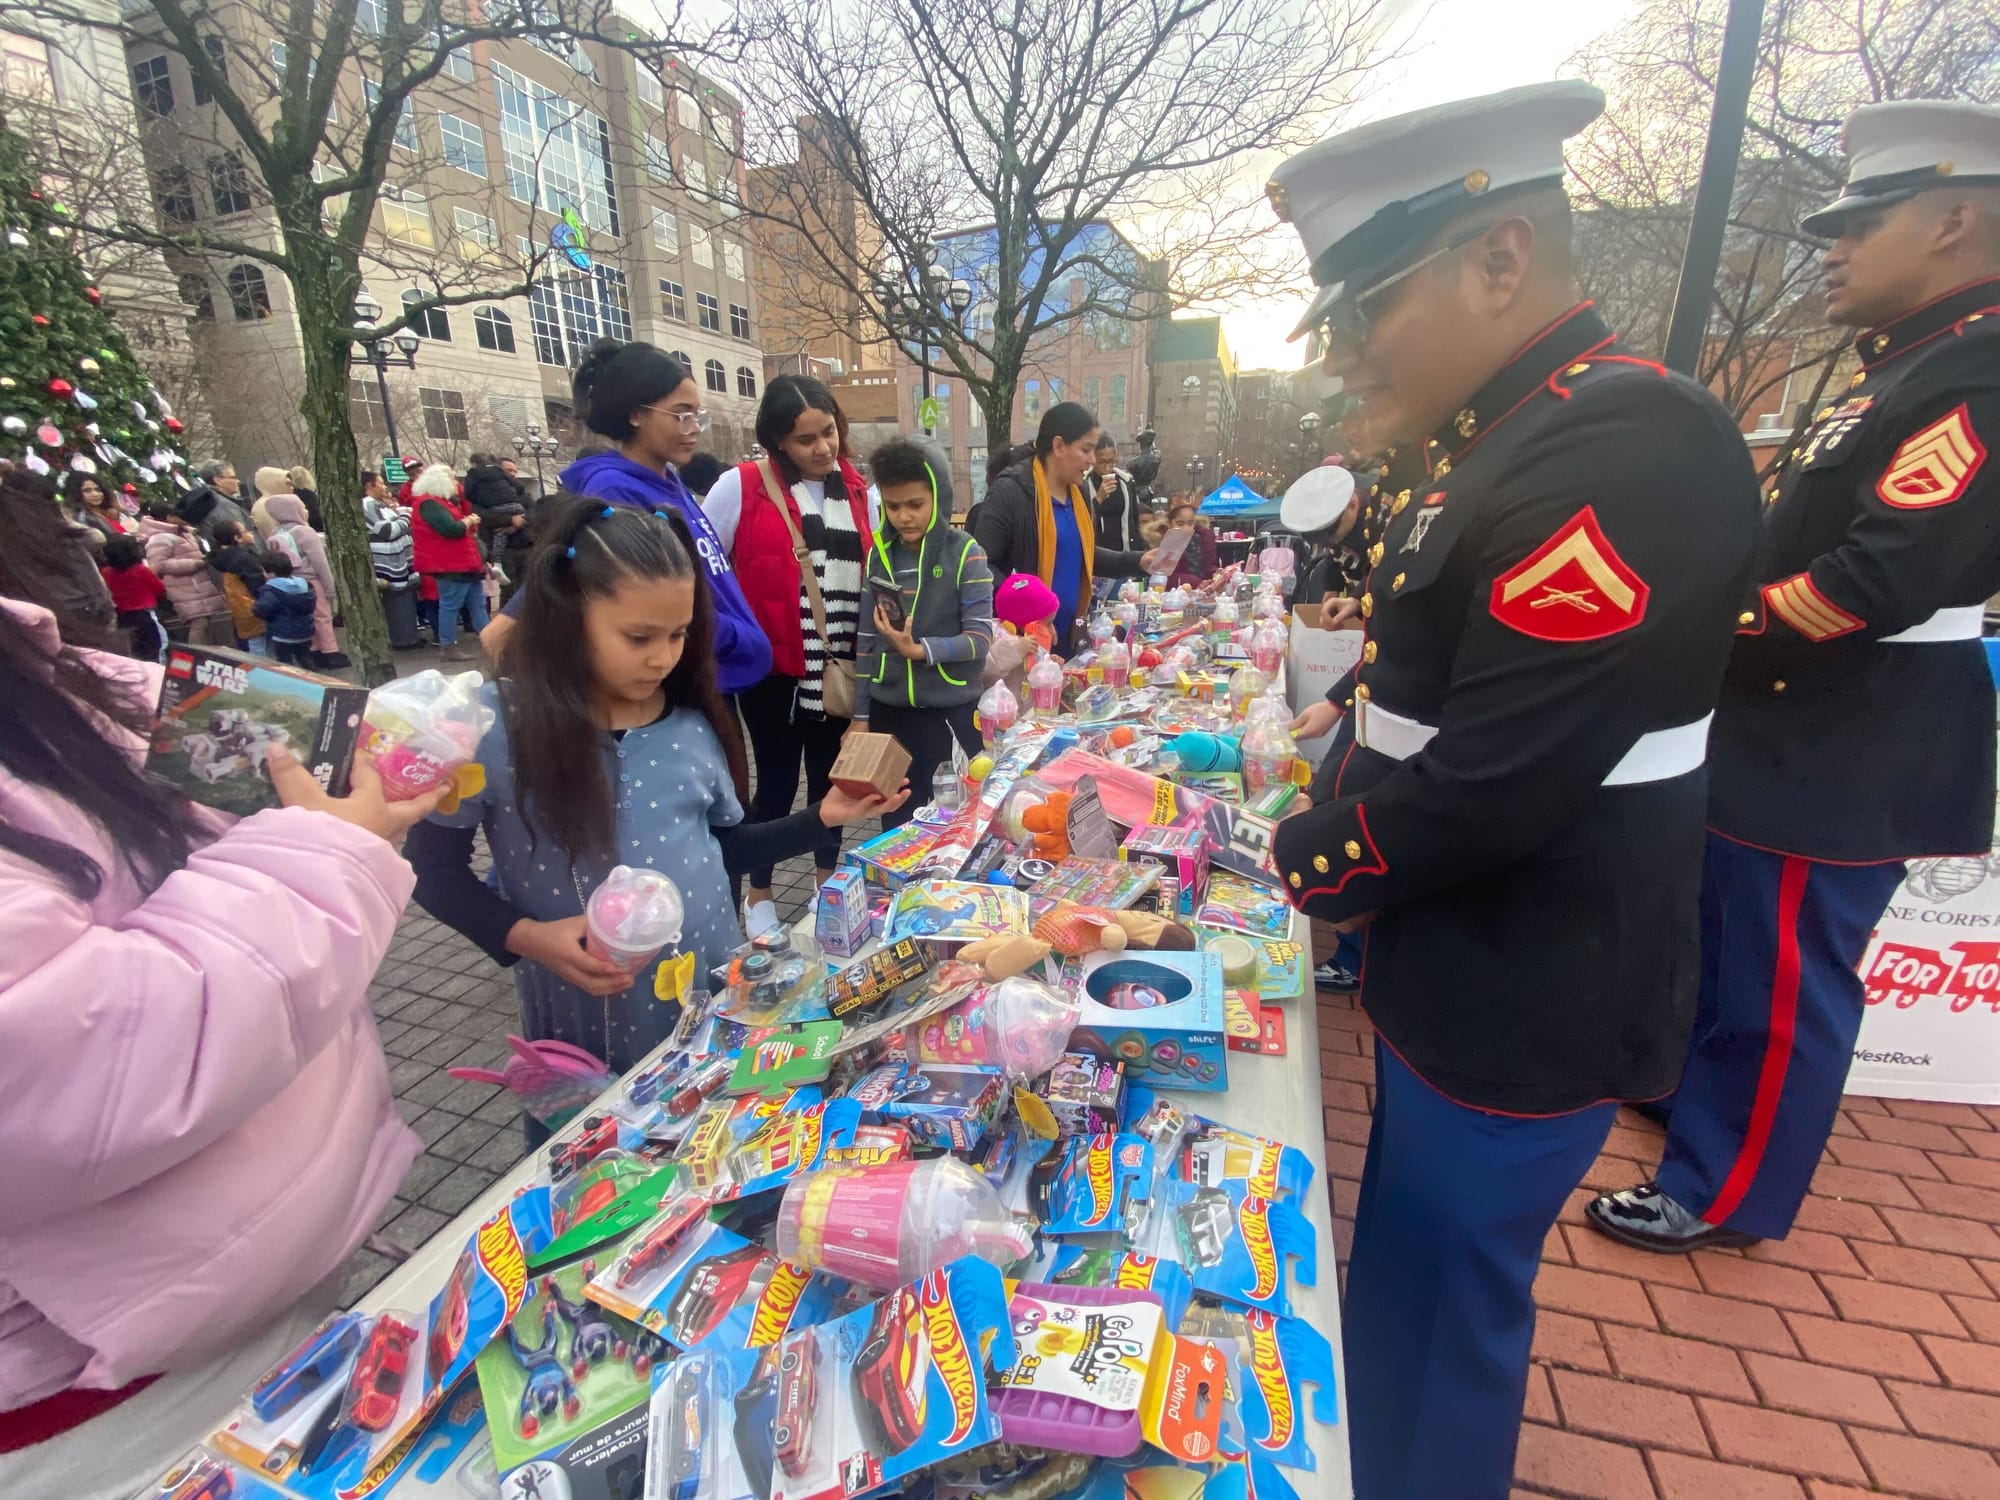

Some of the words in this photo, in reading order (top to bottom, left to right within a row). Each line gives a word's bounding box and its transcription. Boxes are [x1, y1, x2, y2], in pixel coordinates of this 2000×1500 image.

[196, 669, 249, 694] WARS
[197, 659, 249, 682] STAR
[1921, 910, 1992, 927] CORPS
[1872, 951, 1940, 989] FOR
[1961, 962, 2000, 990] TO
[835, 997, 861, 1014] DEAL
[822, 1144, 901, 1166] Slink
[1168, 1361, 1190, 1422] FoxMind
[596, 1435, 612, 1447] de
[569, 1444, 594, 1461] mur
